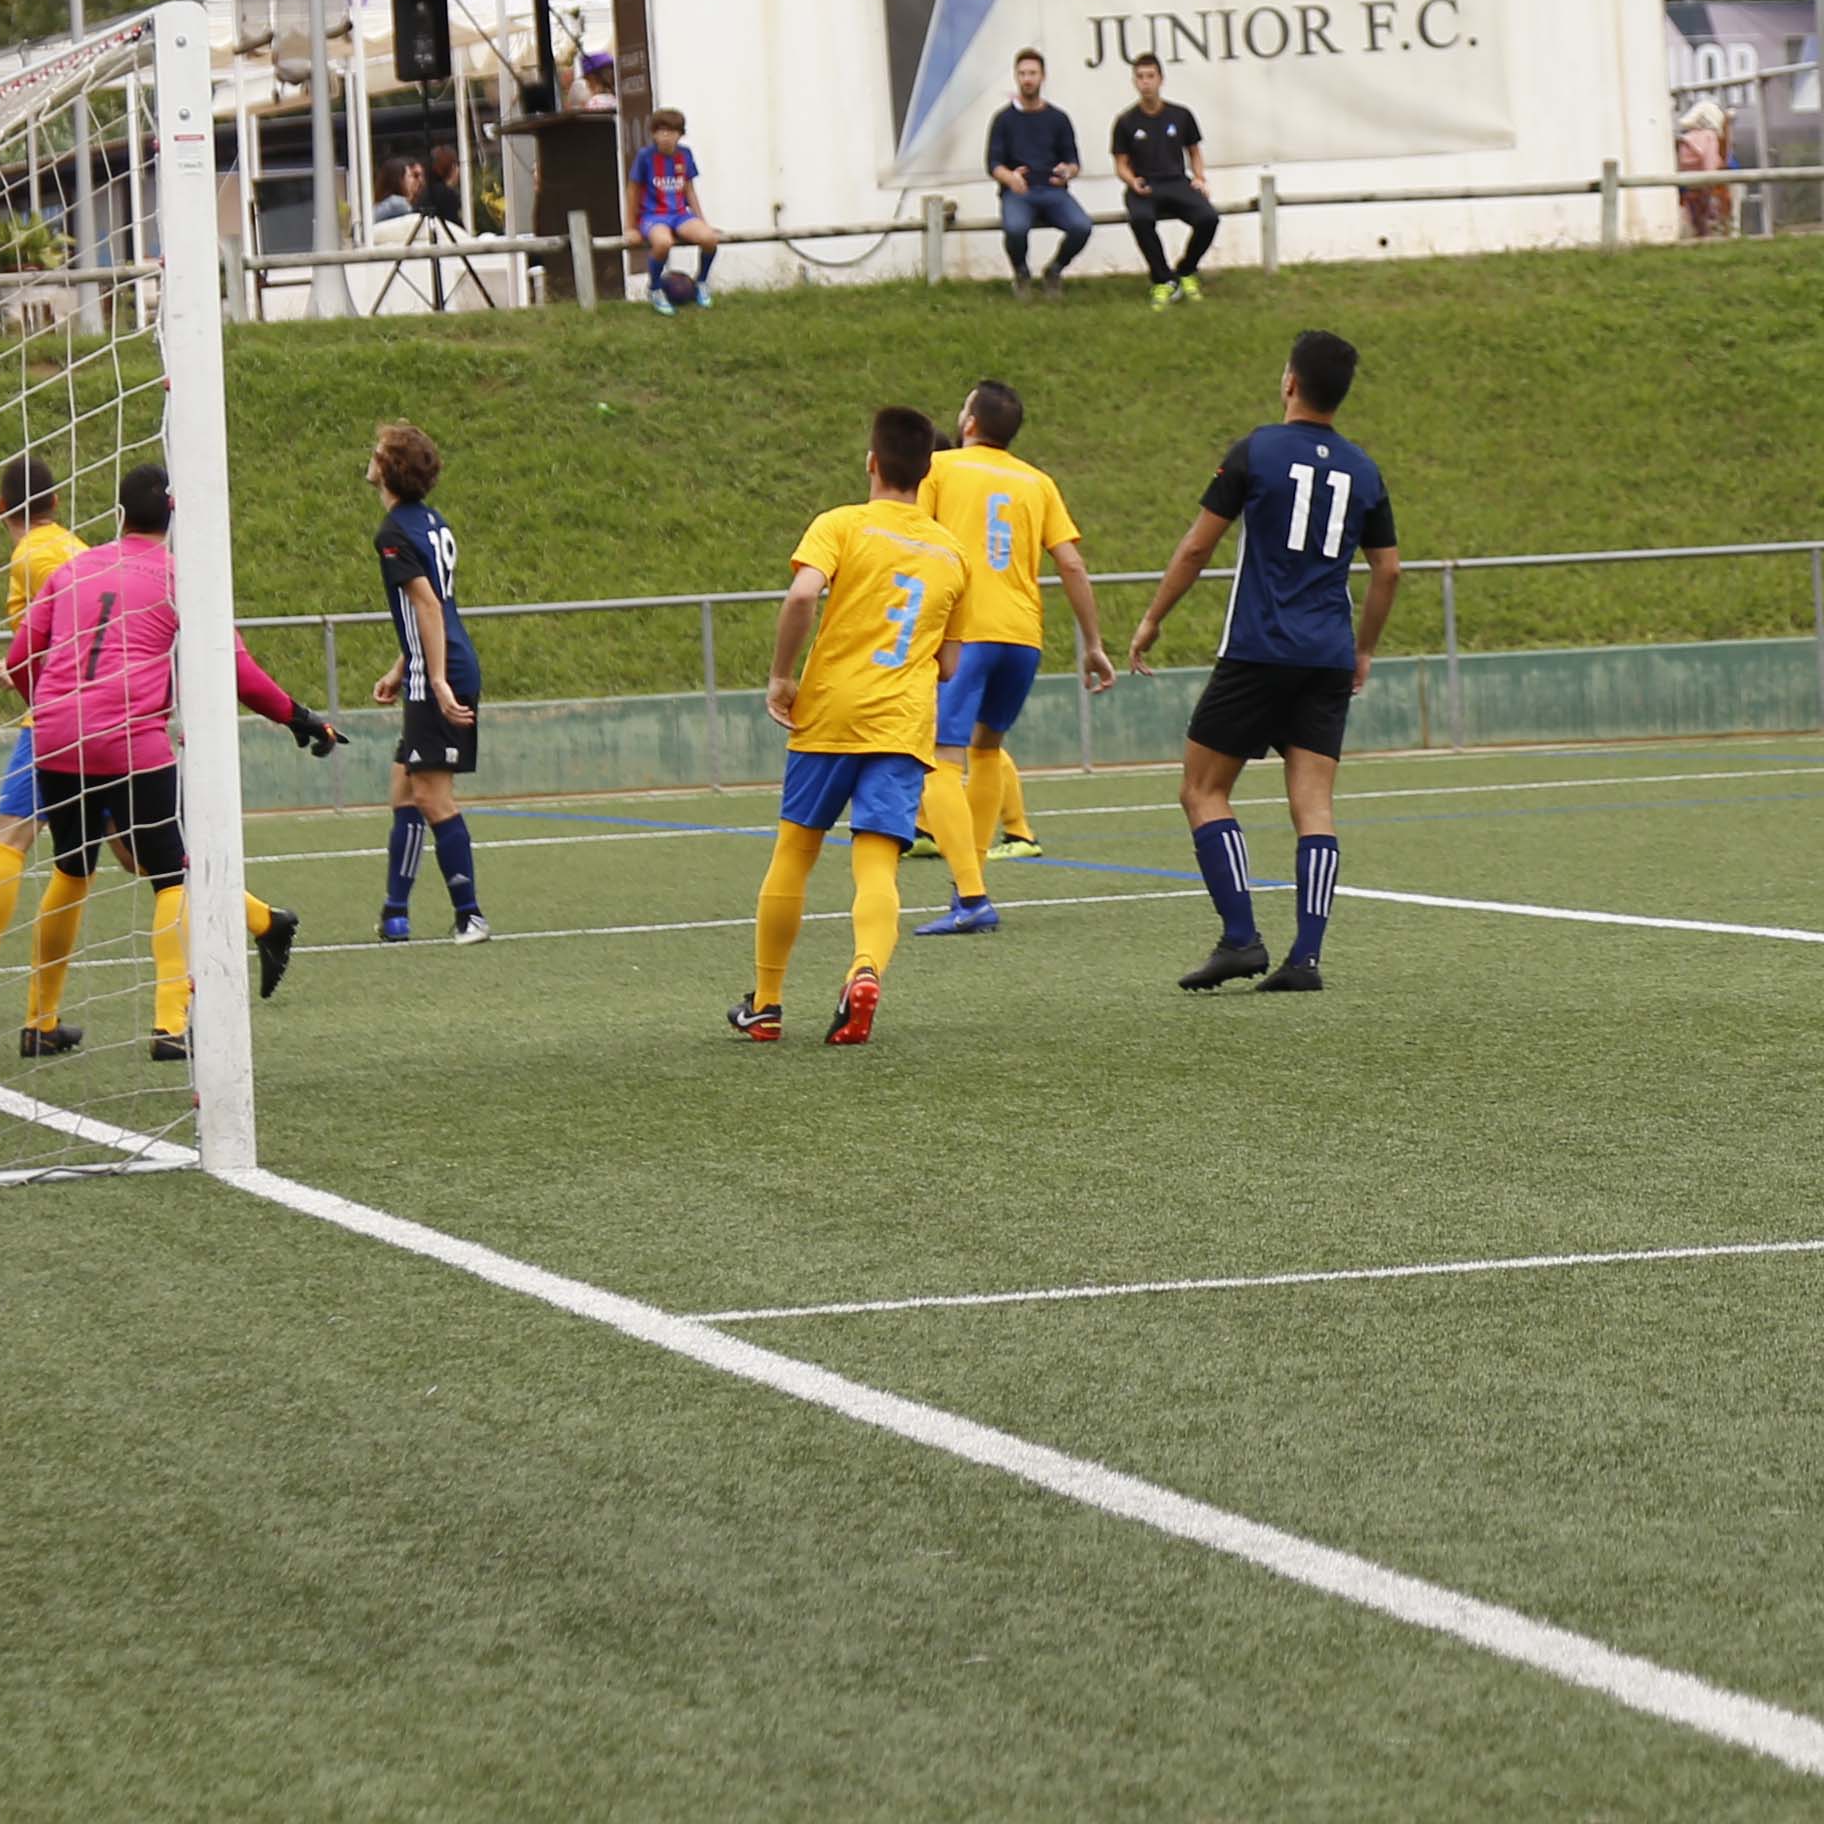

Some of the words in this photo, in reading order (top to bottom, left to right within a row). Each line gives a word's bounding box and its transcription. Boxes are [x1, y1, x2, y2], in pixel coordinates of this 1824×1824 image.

[1084, 2, 1343, 69] JUNIOR
[987, 493, 1012, 571] 6
[1287, 462, 1352, 559] 11
[427, 526, 457, 601] 19
[85, 591, 116, 681] 1
[870, 571, 924, 668] 3
